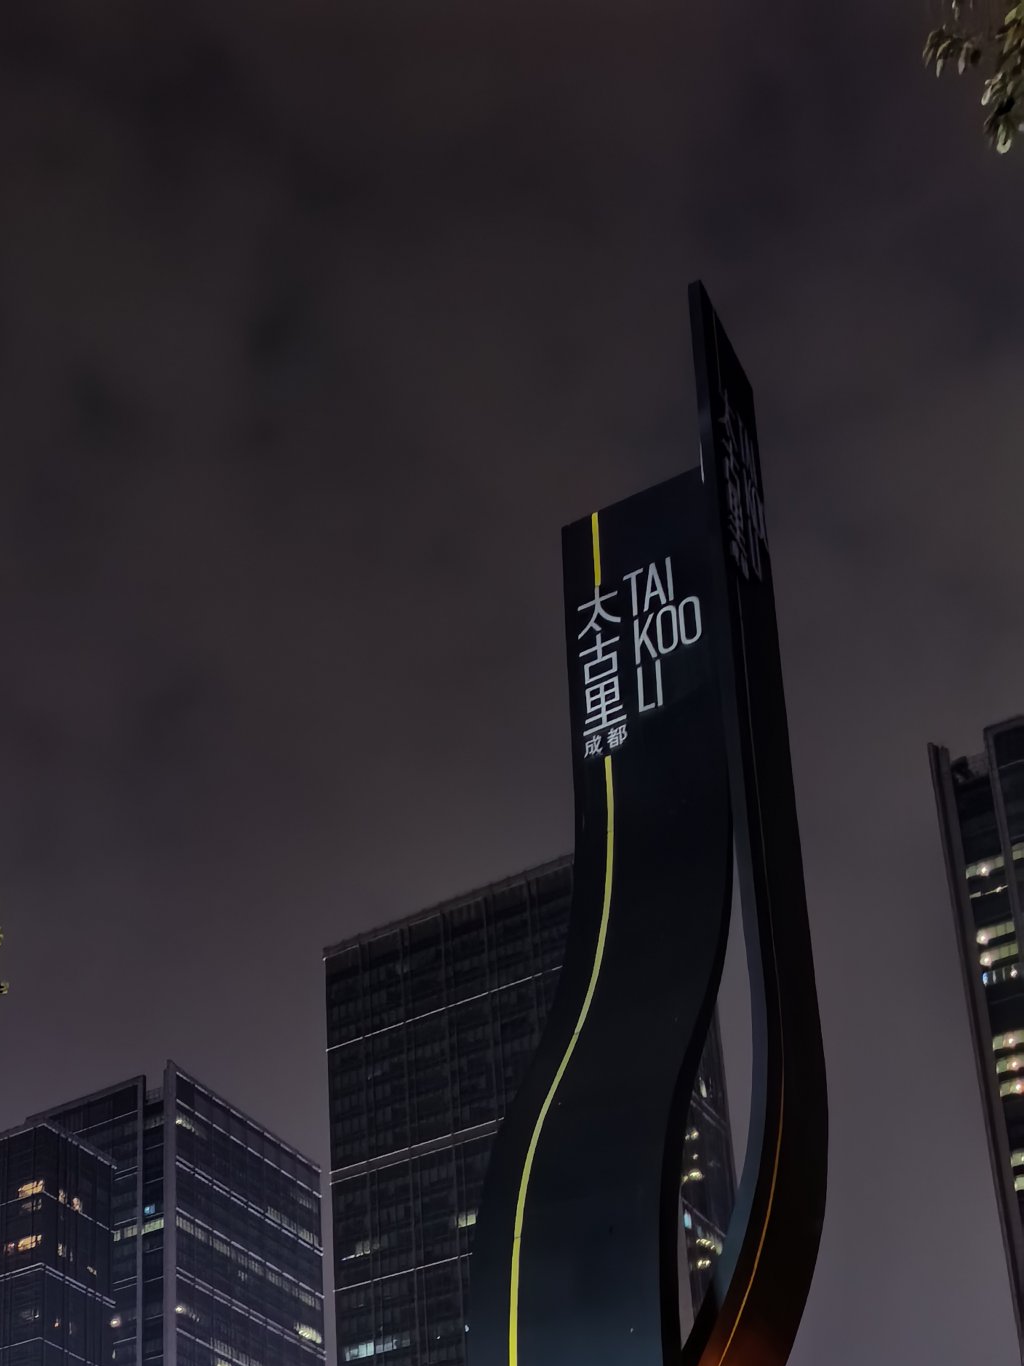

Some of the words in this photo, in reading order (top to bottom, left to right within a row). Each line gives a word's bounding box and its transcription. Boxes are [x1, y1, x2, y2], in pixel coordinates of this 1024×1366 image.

[622, 555, 675, 617] TAI
[577, 586, 627, 737] 太古里
[633, 595, 703, 666] KOO
[636, 658, 664, 713] LI
[583, 723, 629, 759] 成都
